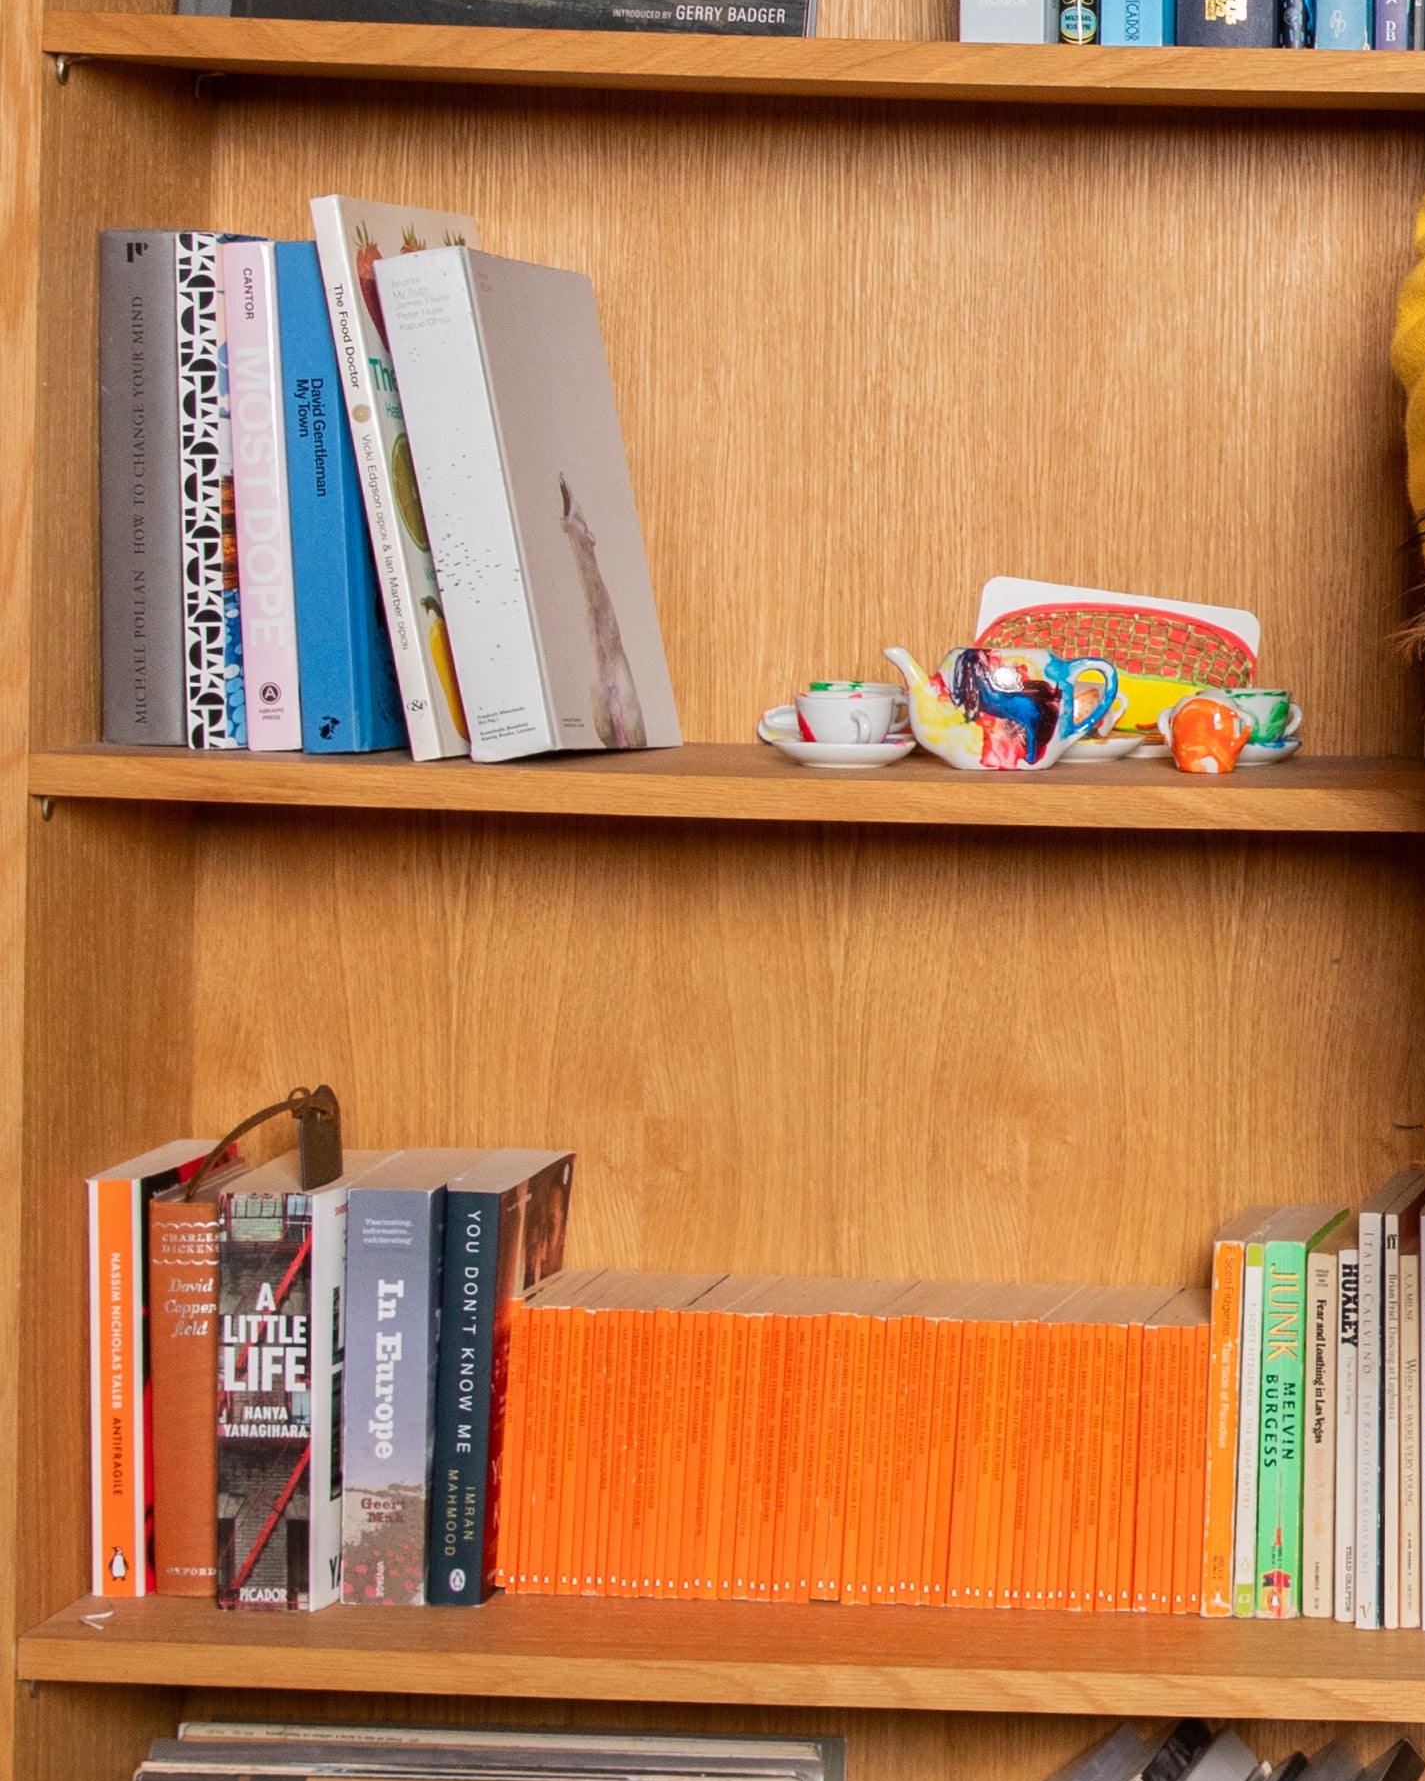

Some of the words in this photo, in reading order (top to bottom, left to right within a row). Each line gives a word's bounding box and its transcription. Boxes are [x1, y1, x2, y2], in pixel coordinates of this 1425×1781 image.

[612, 8, 661, 18] INTRODUCED
[663, 10, 671, 18] BY
[675, 3, 722, 23] GERRY
[728, 5, 786, 24] BADGER
[243, 268, 254, 320] CANTOR
[131, 296, 144, 345] MIND
[131, 352, 144, 398] YOUR
[295, 378, 309, 398] My
[310, 378, 325, 415] David
[132, 405, 145, 477] CHANGE
[297, 401, 311, 437] Town
[314, 419, 329, 497] Gentleman
[132, 478, 145, 506] TO
[132, 512, 145, 555] HOW
[132, 569, 146, 640] POLLAN
[134, 642, 147, 724] MICHAEL
[465, 1210, 481, 1254] YOU
[255, 1283, 276, 1311] A
[377, 1279, 404, 1321] In
[463, 1267, 479, 1336] DON'T
[1265, 1264, 1299, 1363] JUNK
[222, 1315, 307, 1344] LITTLE
[223, 1347, 307, 1393] LIFE
[459, 1347, 475, 1413] KNOW
[367, 1332, 402, 1460] Europe
[457, 1424, 473, 1455] ME
[1264, 1374, 1279, 1467] BURGESS
[1282, 1382, 1295, 1460] MELVIN
